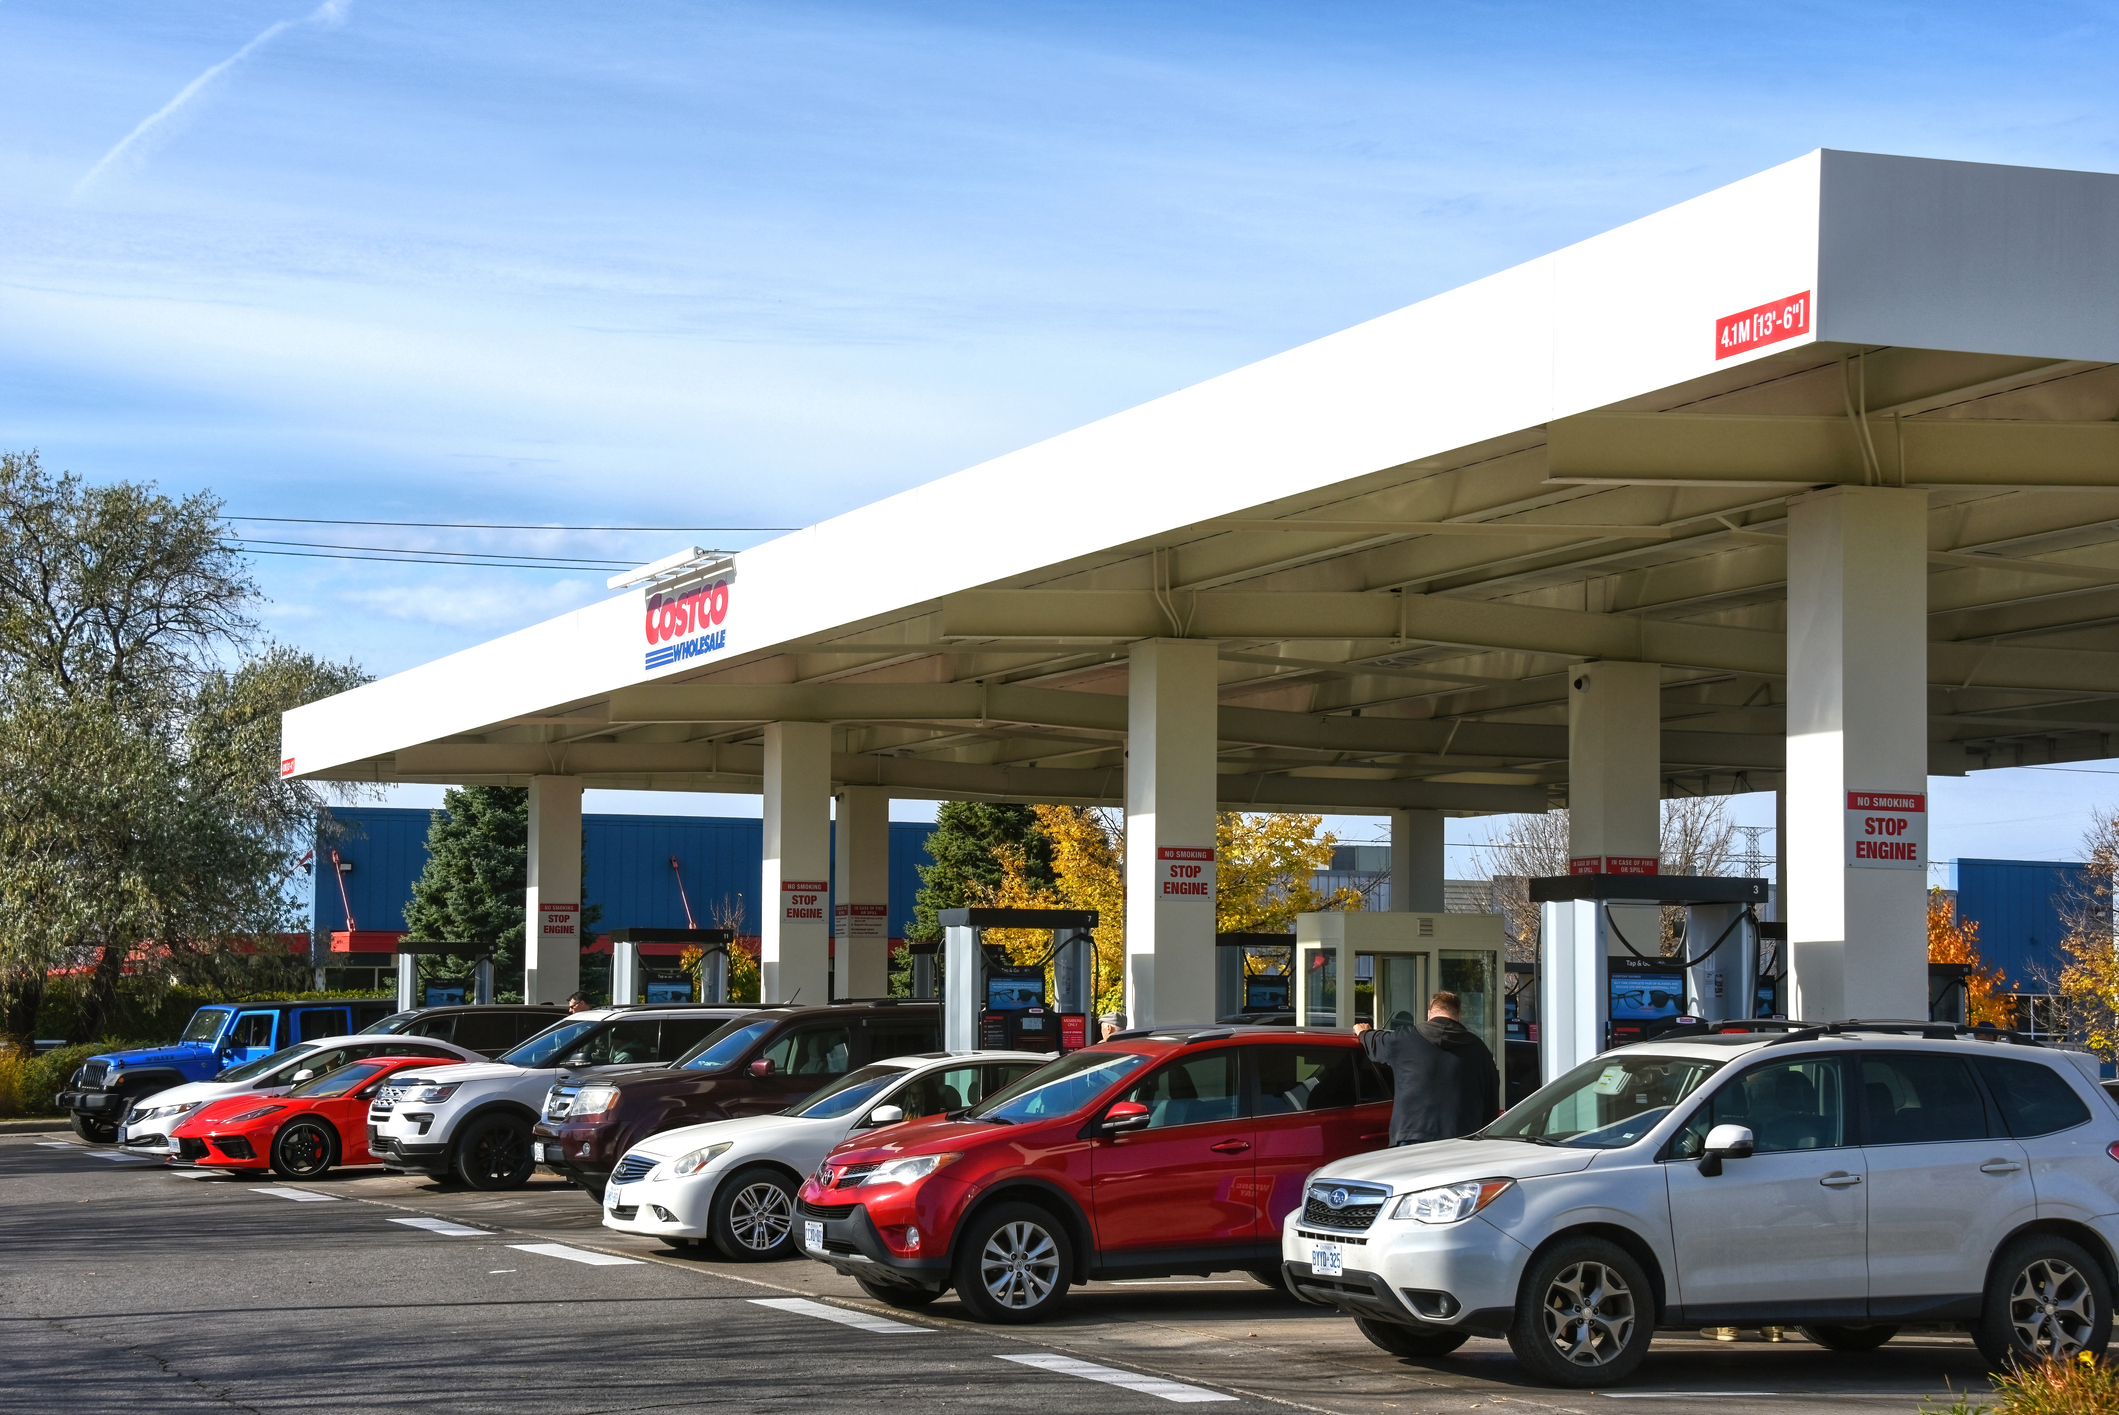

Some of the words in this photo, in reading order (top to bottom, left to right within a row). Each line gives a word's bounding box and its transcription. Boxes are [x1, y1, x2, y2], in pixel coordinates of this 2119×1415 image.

[1720, 318, 1750, 348] 4.1M
[645, 578, 729, 646] COSTCO
[672, 628, 727, 663] WHOLESALE
[1857, 796, 1870, 807] NO
[1872, 797, 1915, 809] SMOKING
[1864, 816, 1908, 836] STOP
[1164, 850, 1174, 858] NO
[1175, 850, 1207, 859] SMOKING
[1855, 840, 1917, 861] ENGINE
[1170, 864, 1202, 878] STOP
[1163, 881, 1208, 895] ENGINE
[1753, 885, 1759, 894] 3
[791, 894, 818, 905] STOP
[548, 914, 570, 923] STOP
[786, 907, 823, 919] ENGINE
[543, 925, 575, 934] ENGINE
